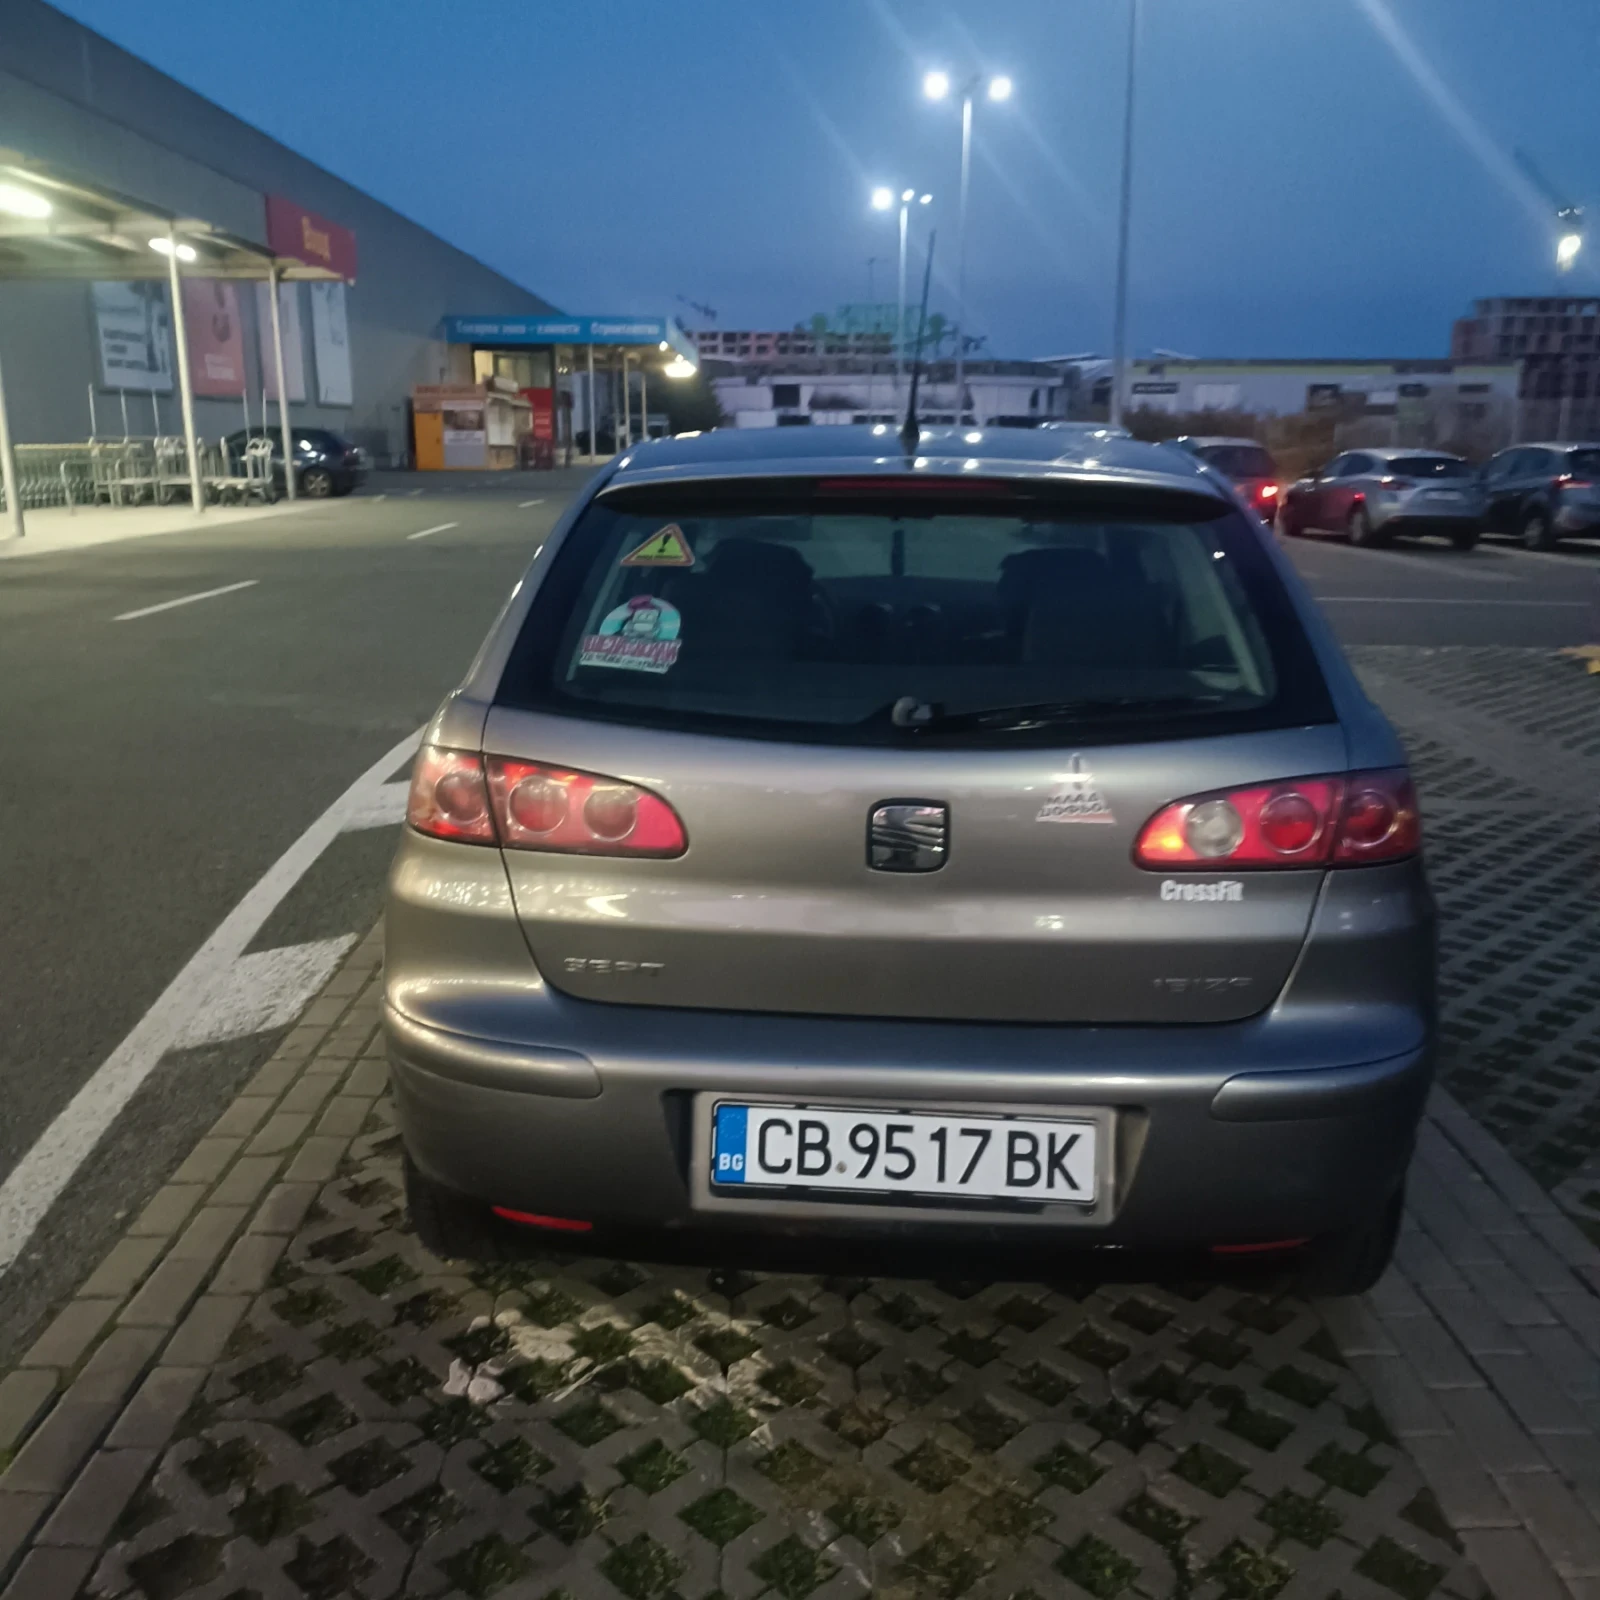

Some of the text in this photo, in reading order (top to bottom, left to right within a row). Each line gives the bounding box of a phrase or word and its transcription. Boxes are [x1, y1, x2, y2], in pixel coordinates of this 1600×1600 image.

[1160, 879, 1244, 901] CrossFit
[564, 957, 666, 976] SEAT
[718, 1152, 744, 1171] BG
[757, 1117, 1082, 1192] CB 9517 BK
